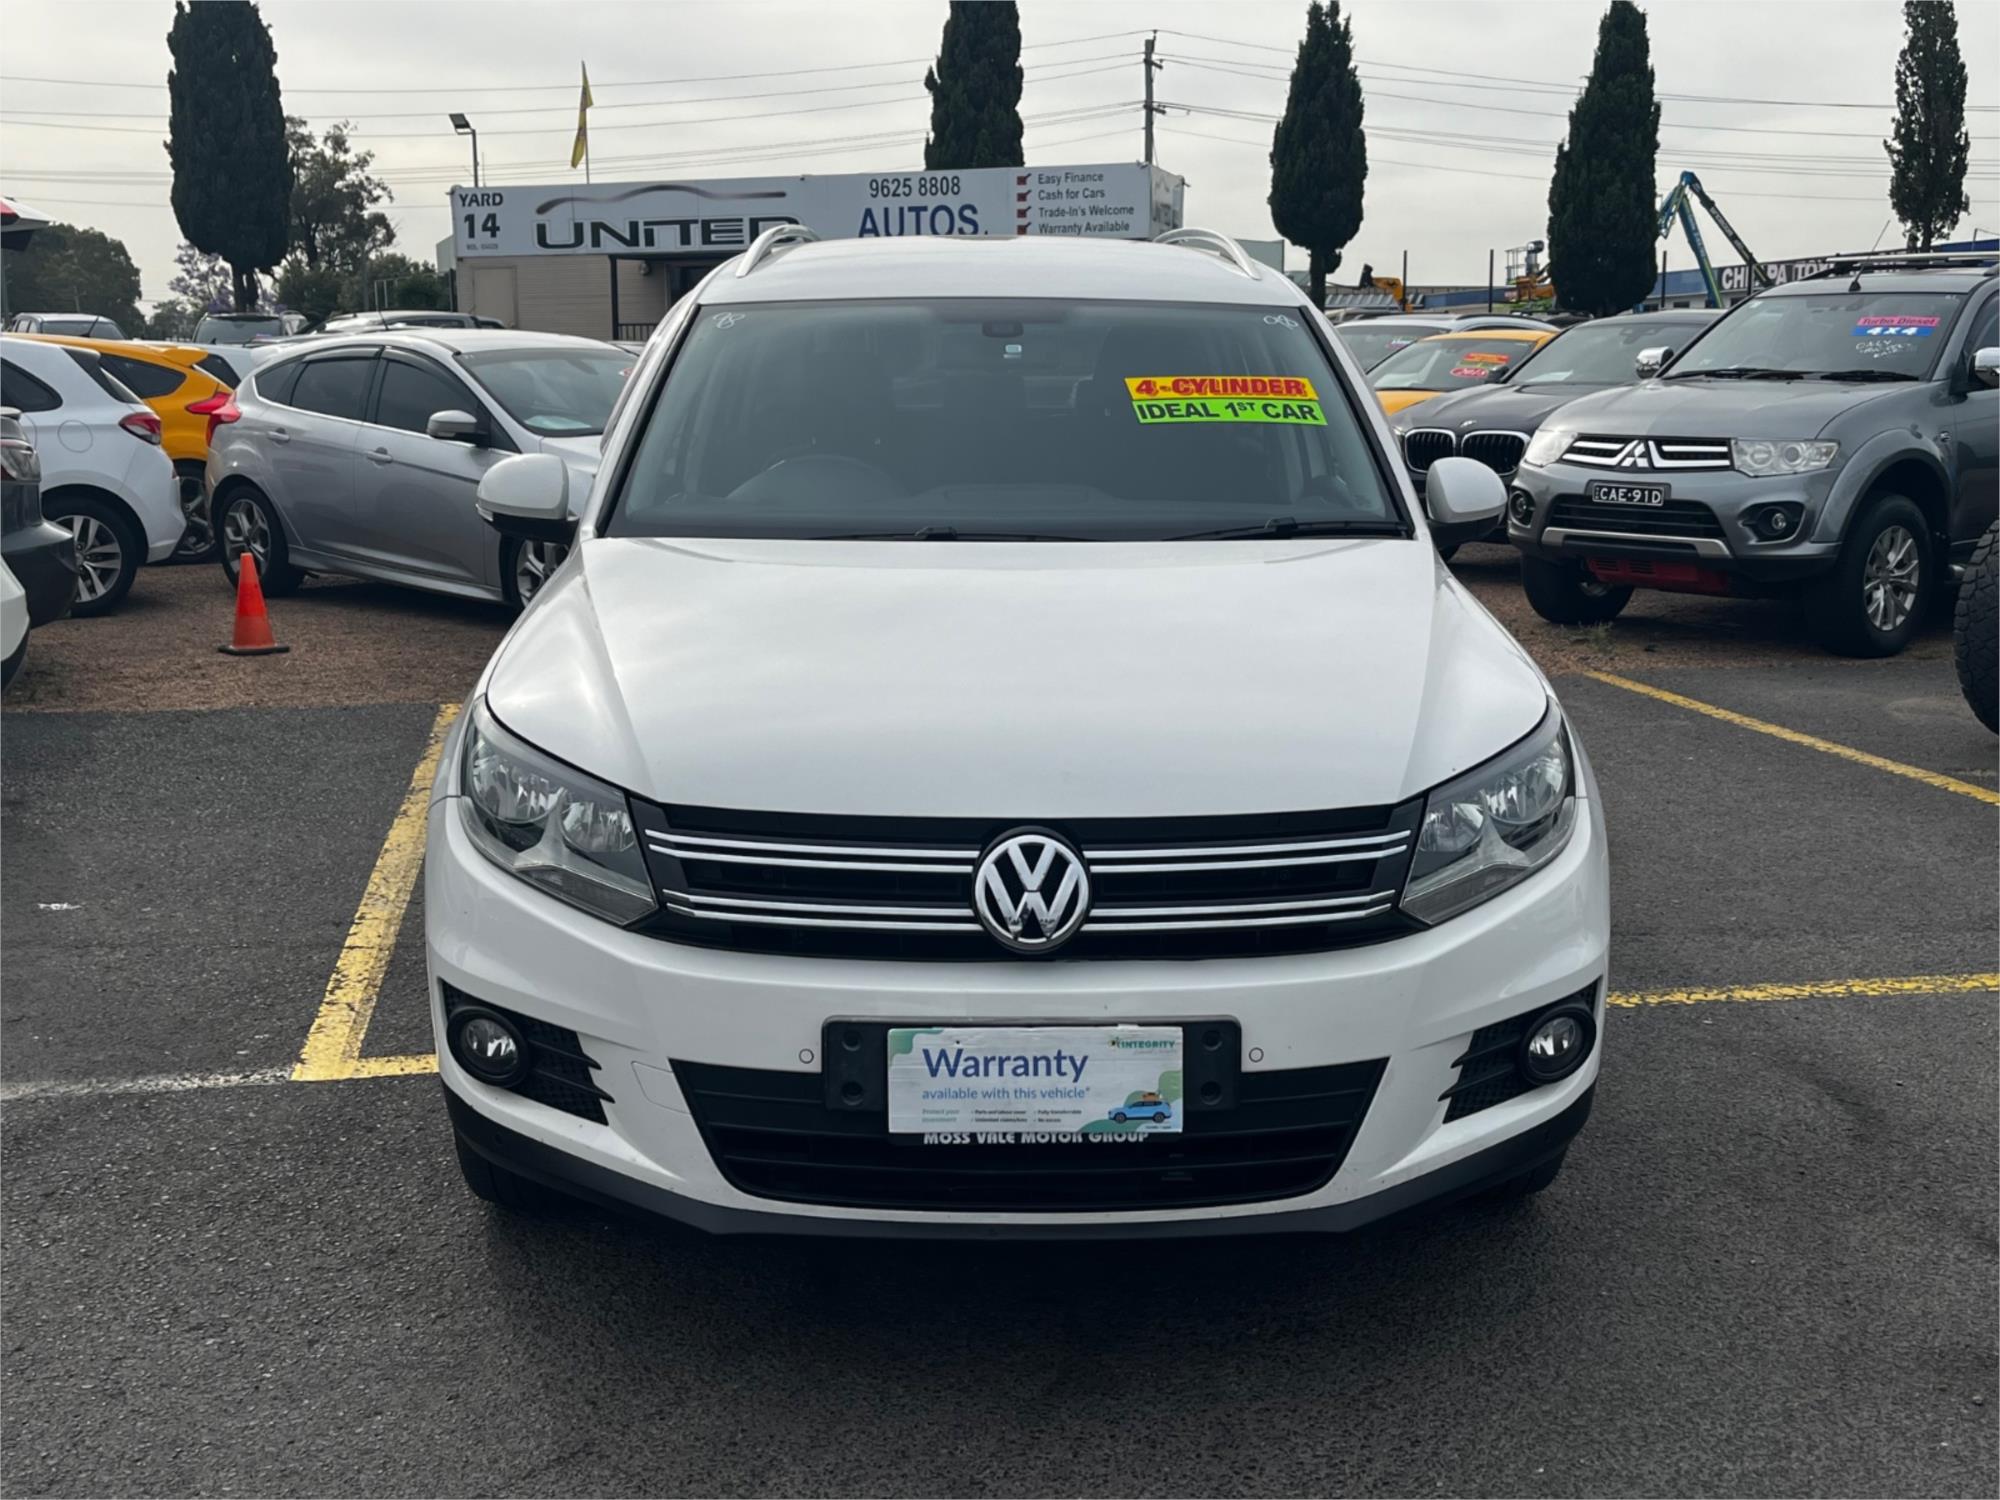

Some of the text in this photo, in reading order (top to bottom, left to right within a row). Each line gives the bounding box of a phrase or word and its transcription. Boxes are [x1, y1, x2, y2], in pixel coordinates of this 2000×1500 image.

[1038, 172, 1104, 186] Easy Finance
[869, 175, 961, 198] 9625 8808
[1038, 187, 1105, 200] Cash for Cars
[459, 193, 503, 207] YARD
[1089, 205, 1134, 216] Welcome
[464, 213, 501, 239] 14
[1038, 221, 1130, 236] Warranty Available
[1136, 378, 1308, 397] 4-CYLINDER
[1137, 403, 1220, 419] IDEAL
[1262, 403, 1320, 420] CAR
[922, 1048, 1089, 1084] Warranty
[922, 1087, 978, 1100] available
[981, 1087, 1010, 1099] with
[1014, 1086, 1037, 1099] this
[924, 1132, 971, 1144] MOSS
[976, 1132, 1015, 1144] VALE
